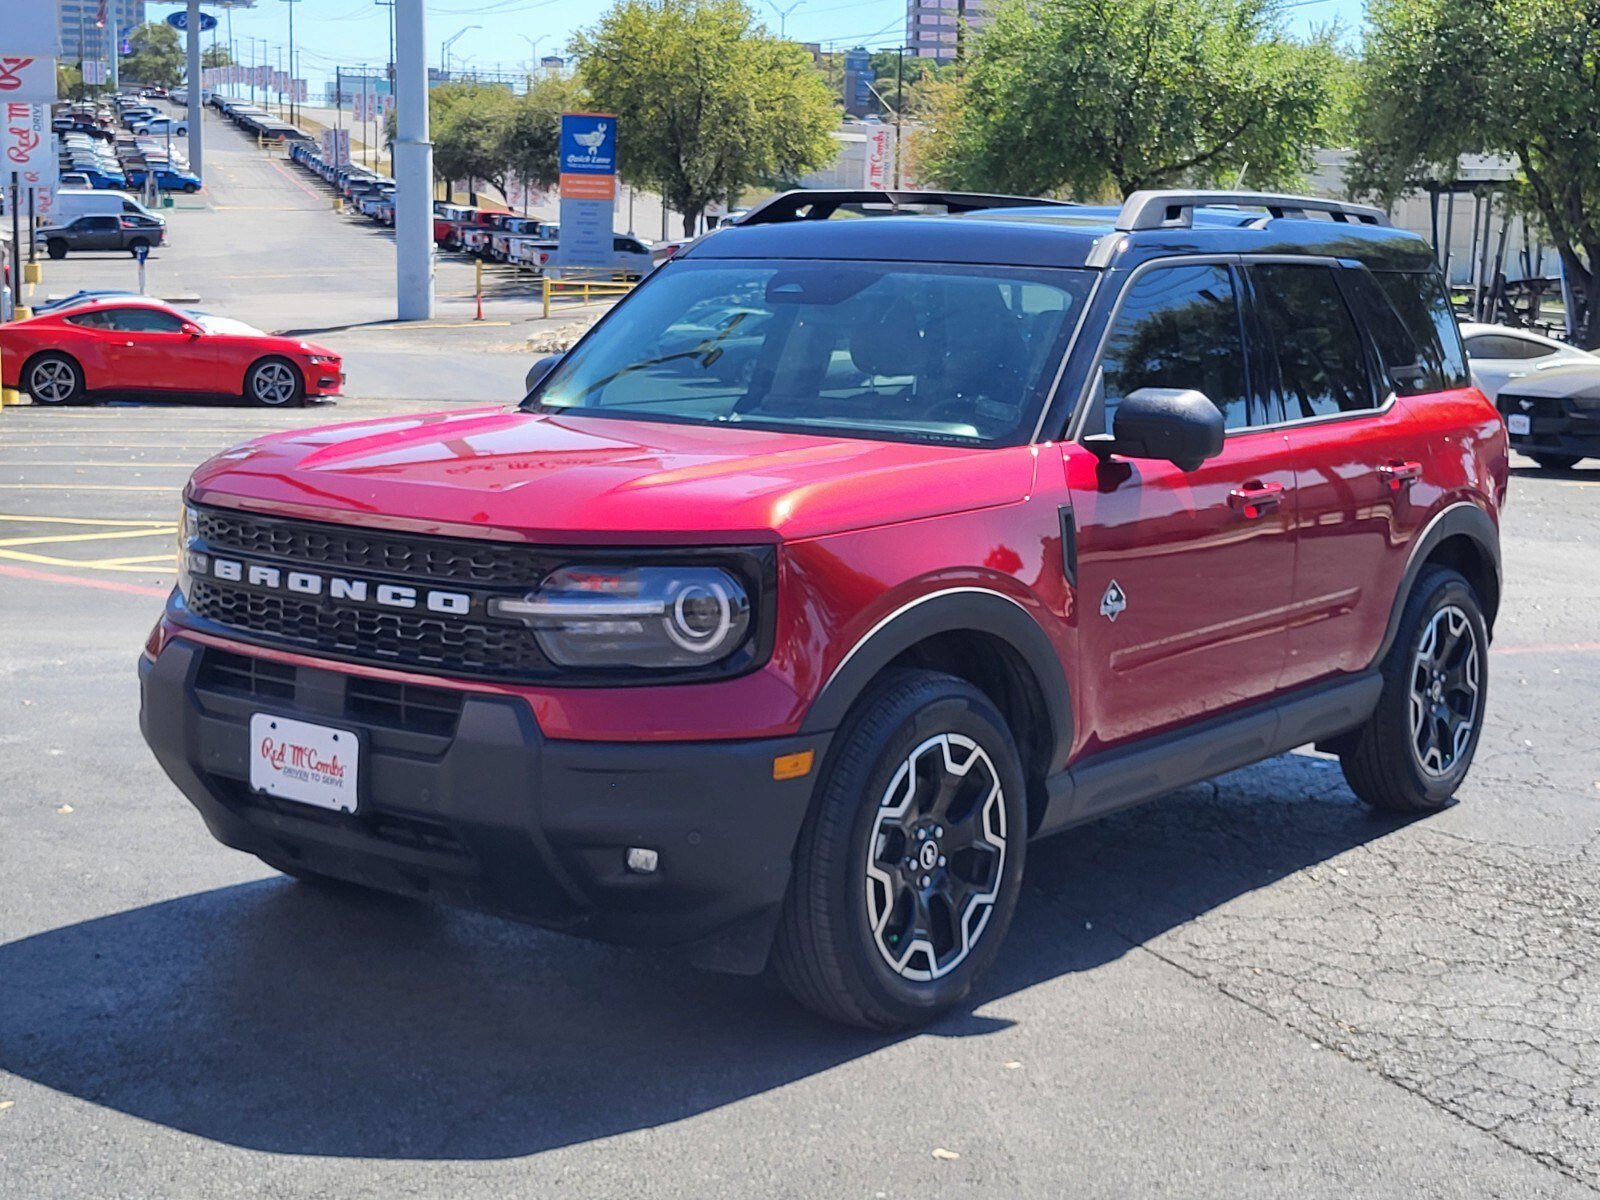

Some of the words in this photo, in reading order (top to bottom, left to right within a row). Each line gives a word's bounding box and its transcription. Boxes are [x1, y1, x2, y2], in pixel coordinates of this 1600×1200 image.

[7, 127, 39, 163] Red
[566, 154, 590, 163] Quick
[214, 559, 470, 616] BRONCO
[261, 737, 287, 771] Red
[289, 744, 344, 778] McCombs
[283, 766, 309, 781] DRIVEN
[311, 772, 321, 783] TO
[322, 776, 344, 788] SERVE
